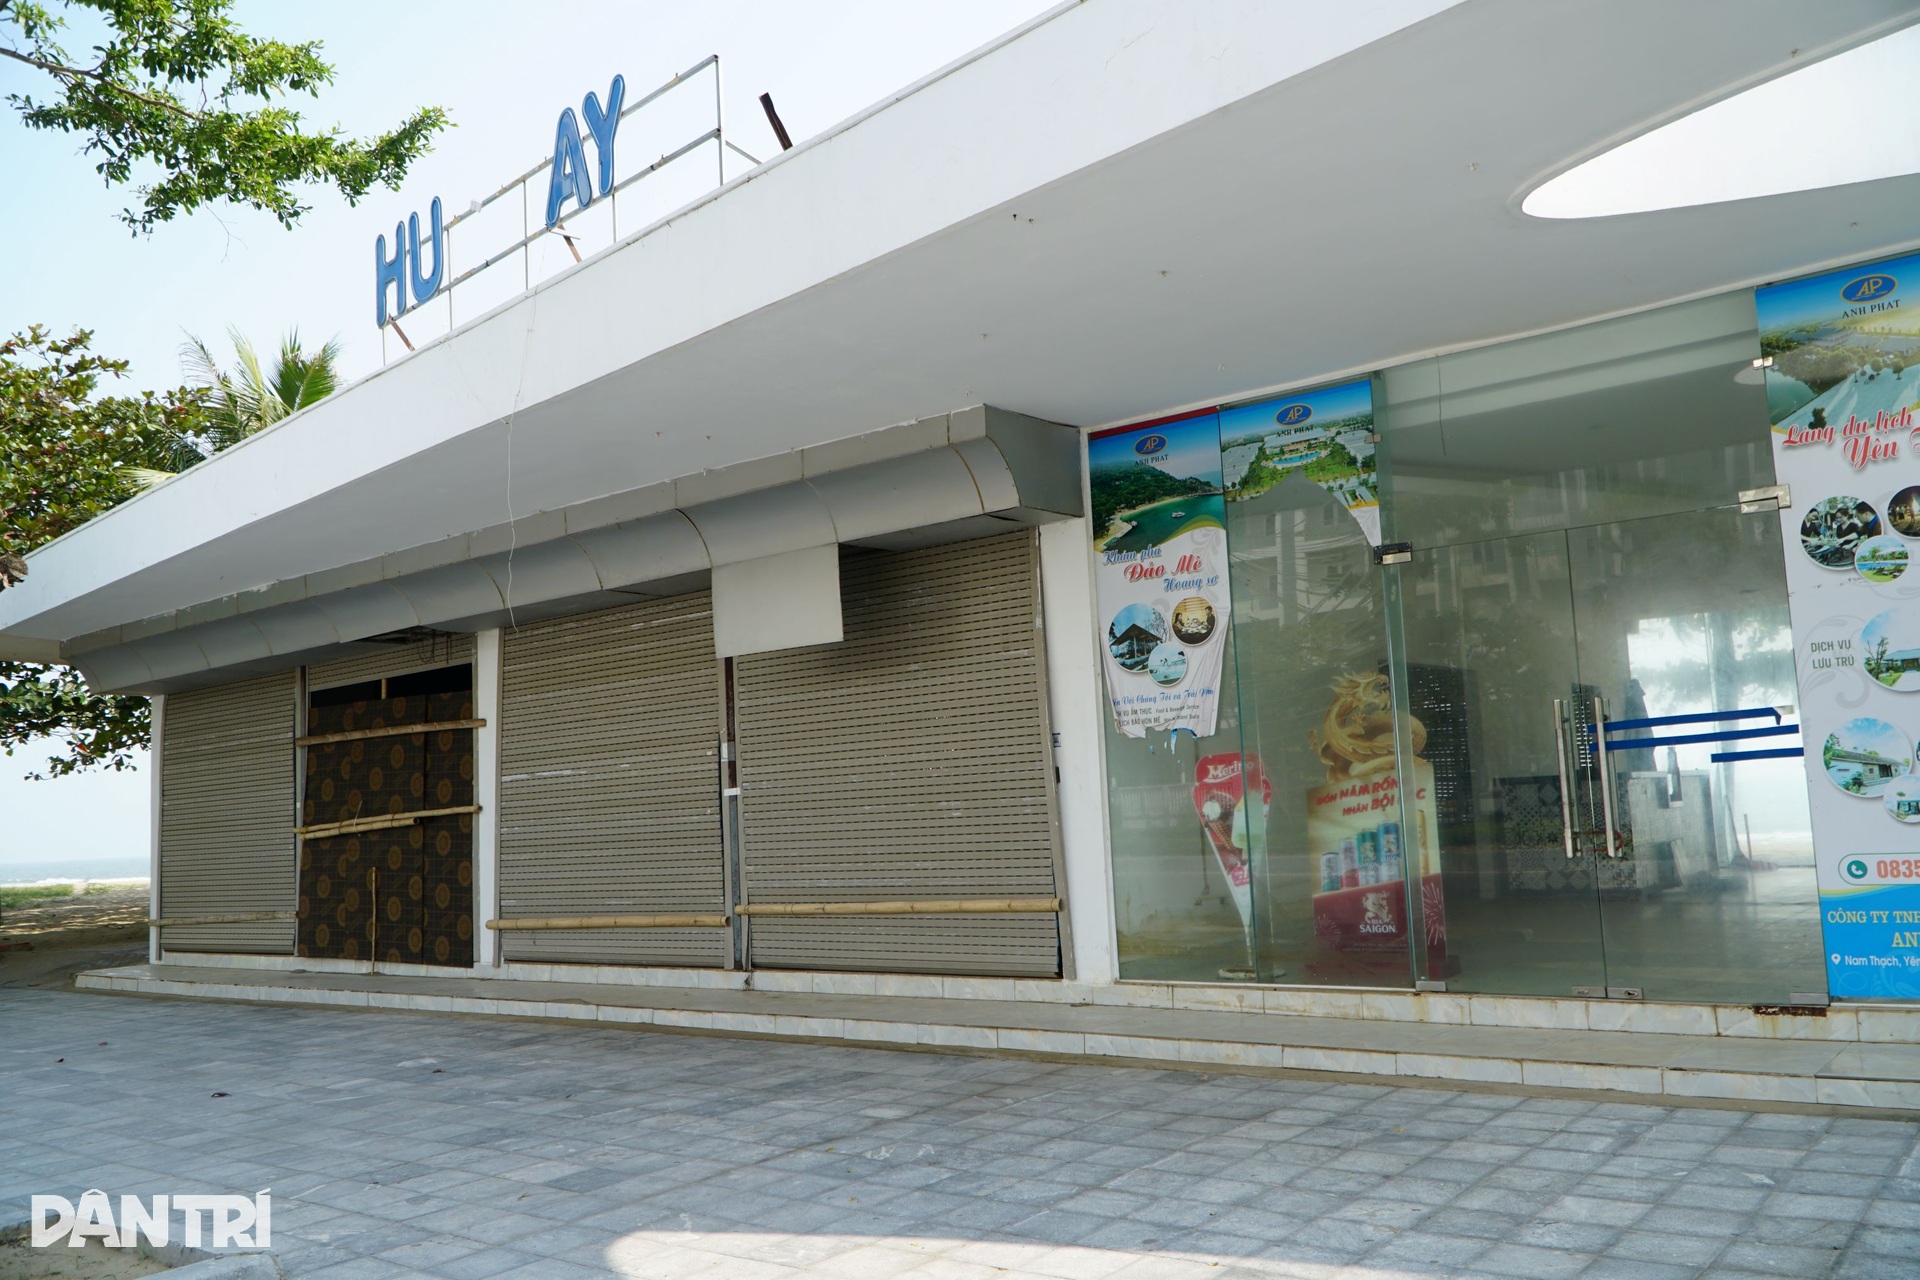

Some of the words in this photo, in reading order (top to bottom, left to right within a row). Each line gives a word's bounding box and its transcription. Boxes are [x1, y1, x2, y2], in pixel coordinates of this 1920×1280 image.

[375, 195, 444, 329] HU
[545, 73, 625, 228] AY
[1842, 307, 1867, 319] ANH
[1782, 423, 1835, 447] Làng
[1842, 414, 1868, 437] du
[1875, 406, 1912, 435] lịch
[1843, 435, 1898, 470] Yên
[1135, 458, 1149, 467] ANH
[1104, 550, 1137, 565] Khám
[1124, 562, 1166, 582] Đảo
[1163, 577, 1204, 592] Hoang
[1810, 641, 1834, 654] DỊCH
[1837, 639, 1851, 651] VỤ
[1812, 657, 1832, 669] LƯU
[1834, 654, 1855, 667] TRÚ
[1827, 907, 1867, 924] CÔNG
[1870, 911, 1889, 924] TY
[1359, 924, 1396, 933] SAIGON
[1891, 932, 1920, 948] AN
[1844, 955, 1868, 966] Nam
[1869, 955, 1902, 969] Thạch,
